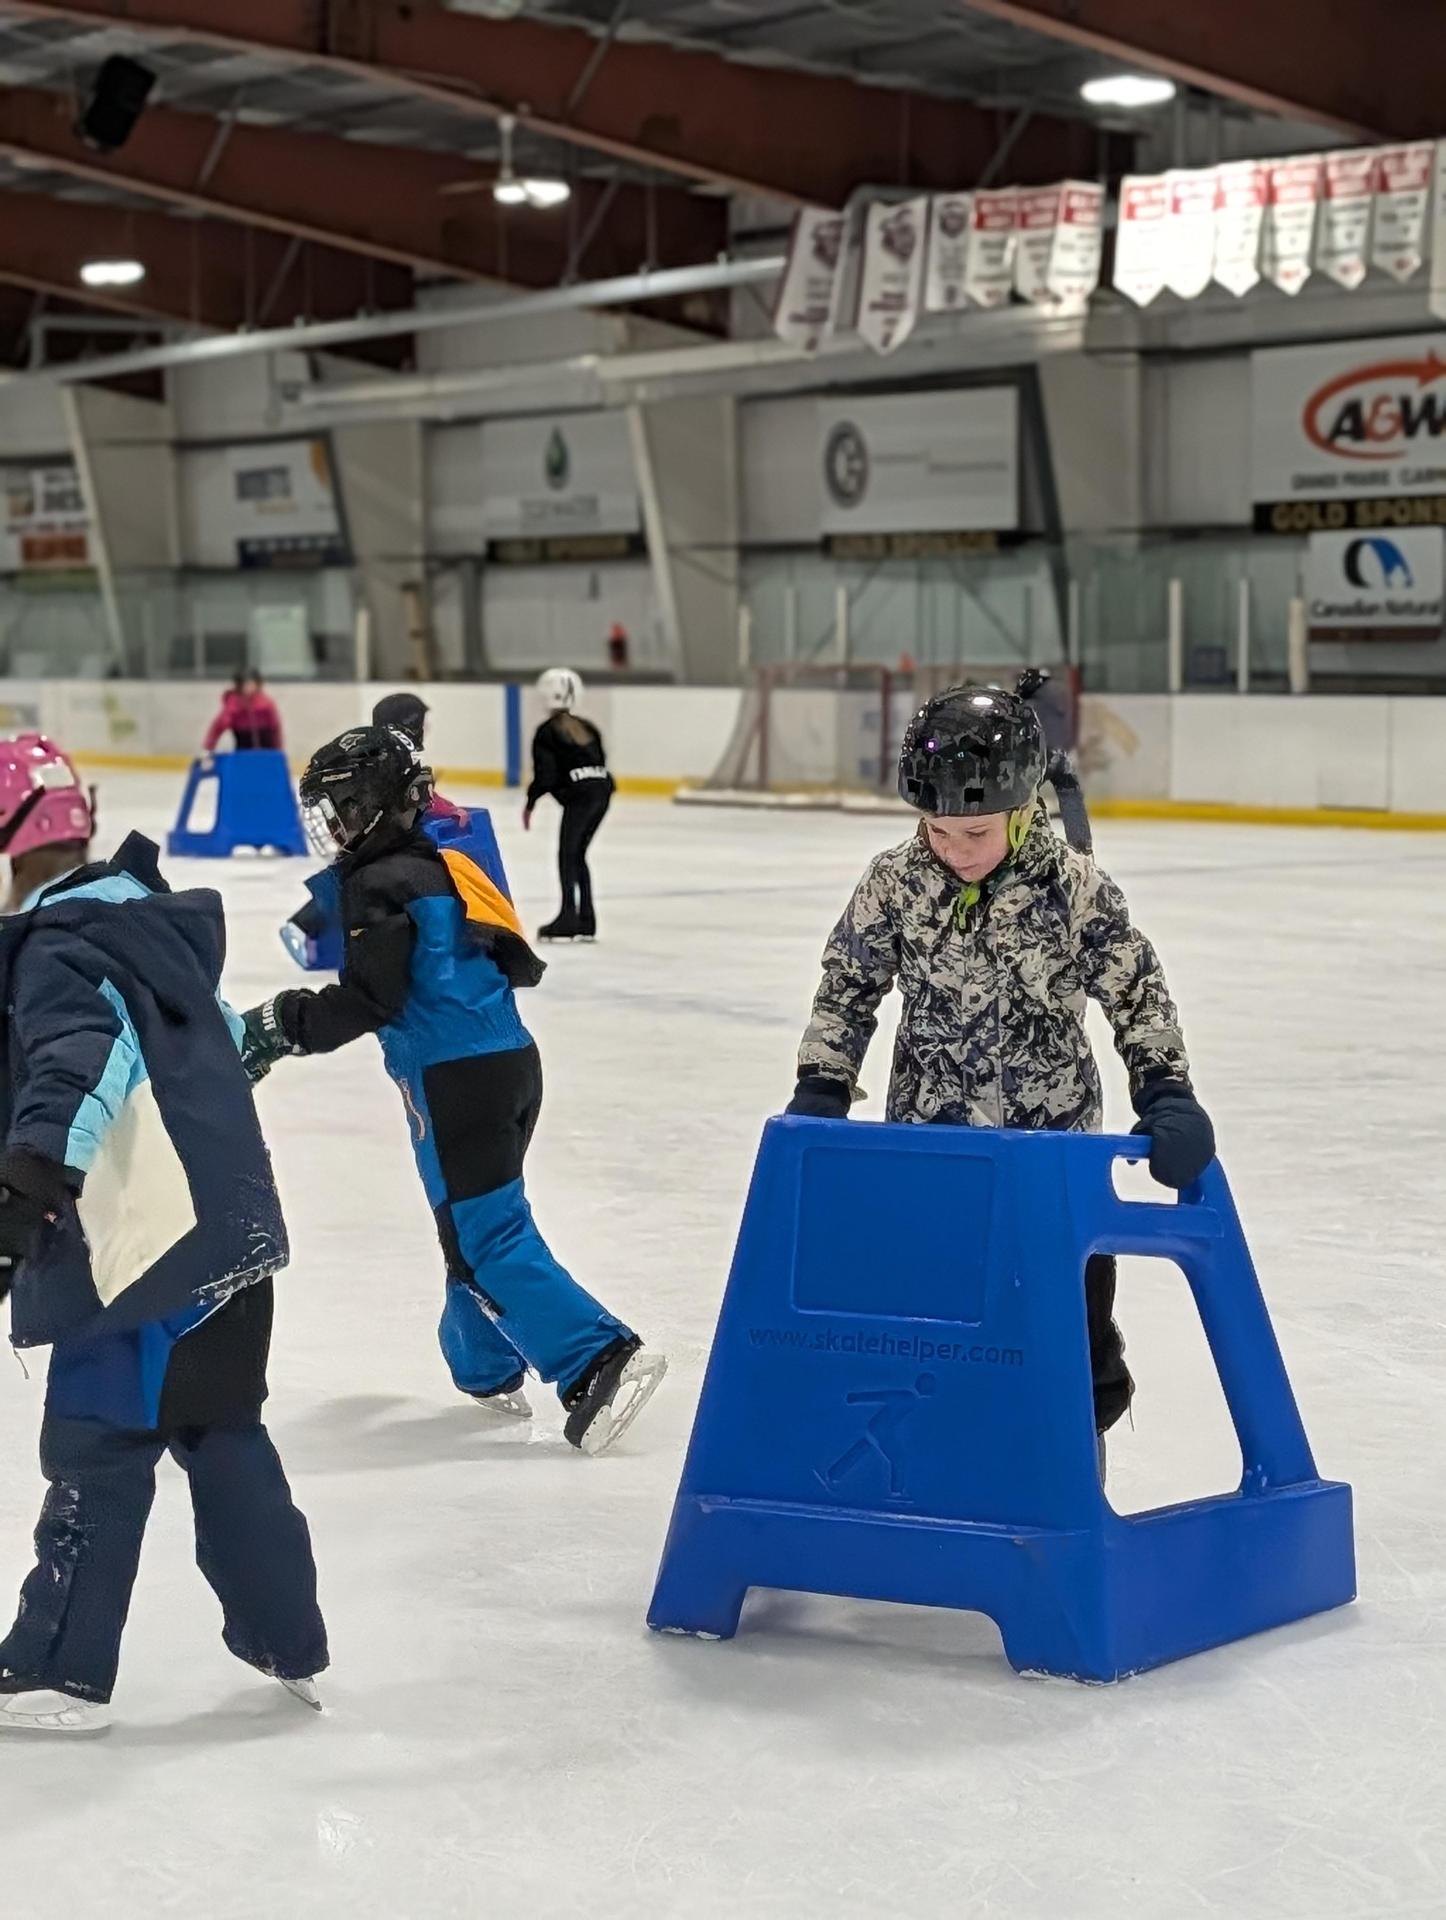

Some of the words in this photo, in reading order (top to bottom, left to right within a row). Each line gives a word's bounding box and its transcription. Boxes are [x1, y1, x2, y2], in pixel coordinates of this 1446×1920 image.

[1327, 393, 1446, 444] A&W
[1271, 501, 1347, 530] GOLD
[1310, 599, 1381, 618] Canadian
[1384, 598, 1440, 616] Natural
[749, 1327, 1024, 1367] www.skatehelper.com
